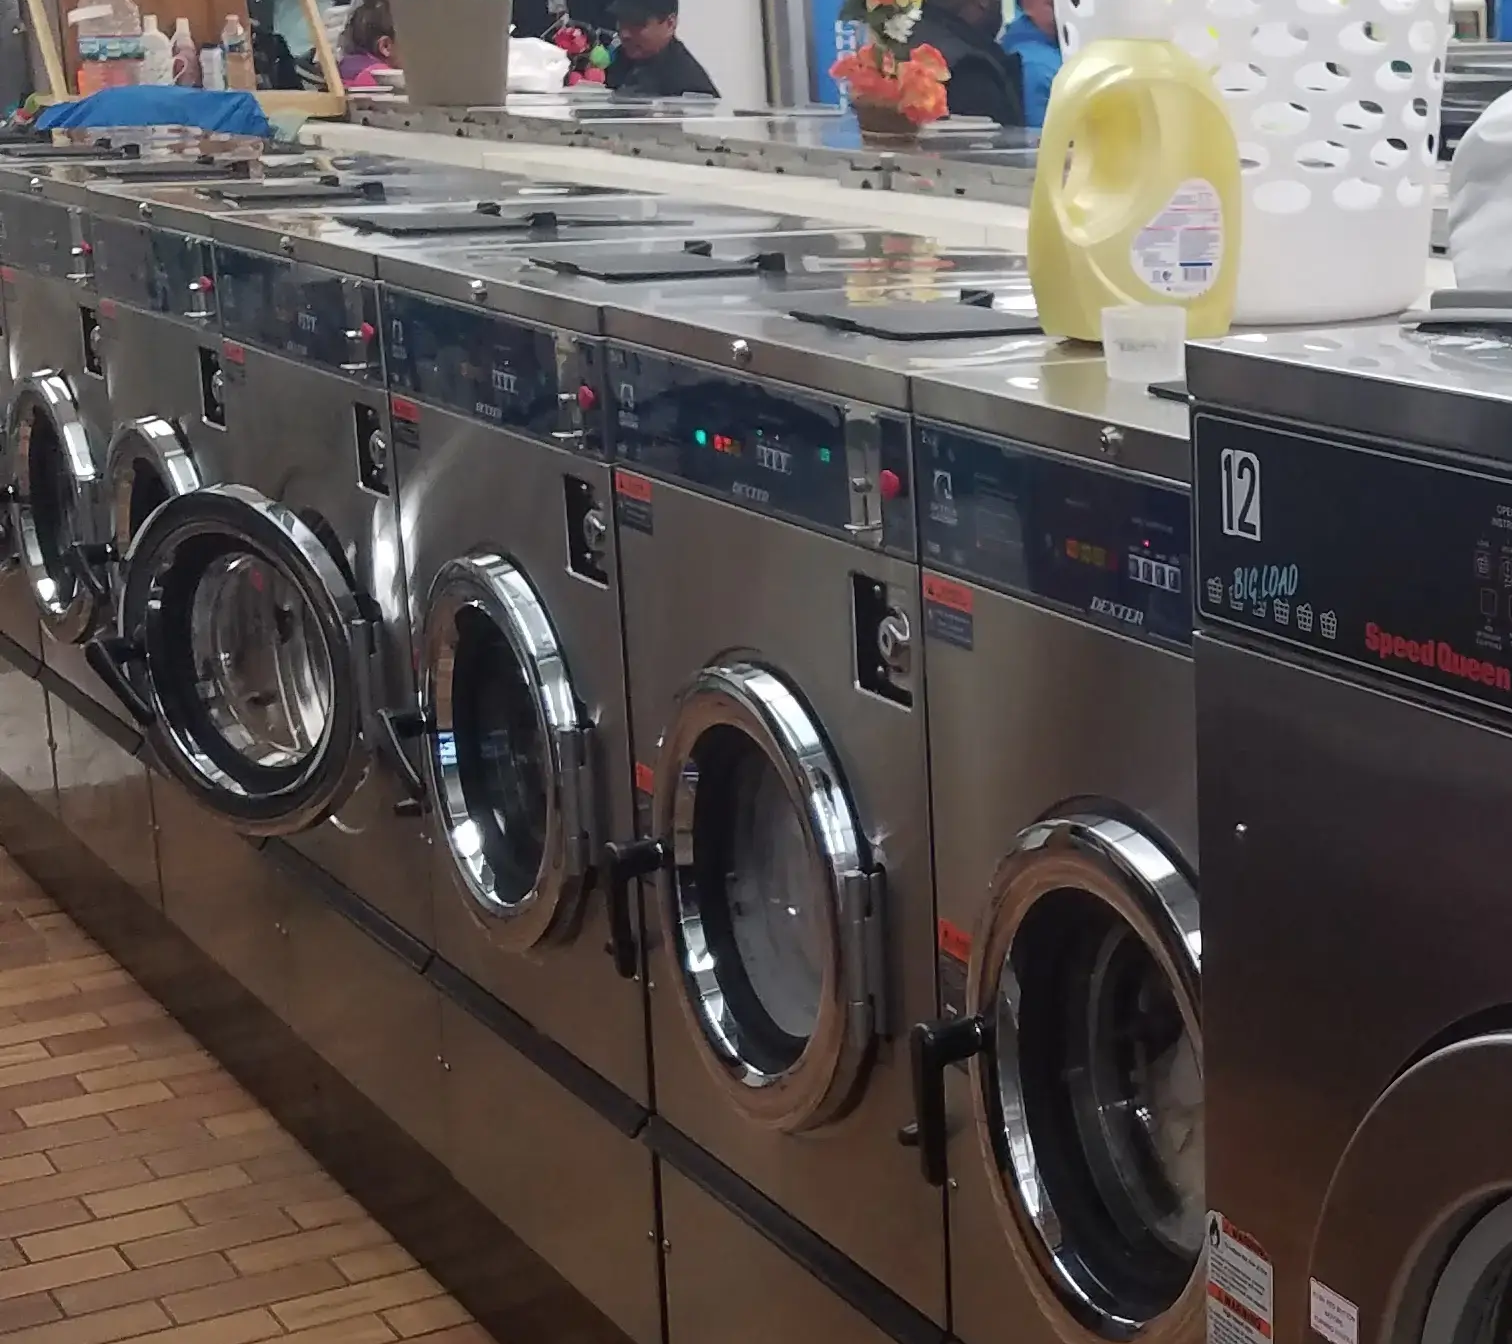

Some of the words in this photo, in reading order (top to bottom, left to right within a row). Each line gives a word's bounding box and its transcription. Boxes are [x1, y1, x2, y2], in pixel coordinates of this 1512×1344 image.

[1223, 453, 1259, 537] 12
[1090, 595, 1145, 626] DEXTER
[1234, 565, 1259, 607] BIG
[1261, 564, 1299, 599] LOAD
[1365, 622, 1440, 668] Speed
[1437, 641, 1511, 690] Queen
